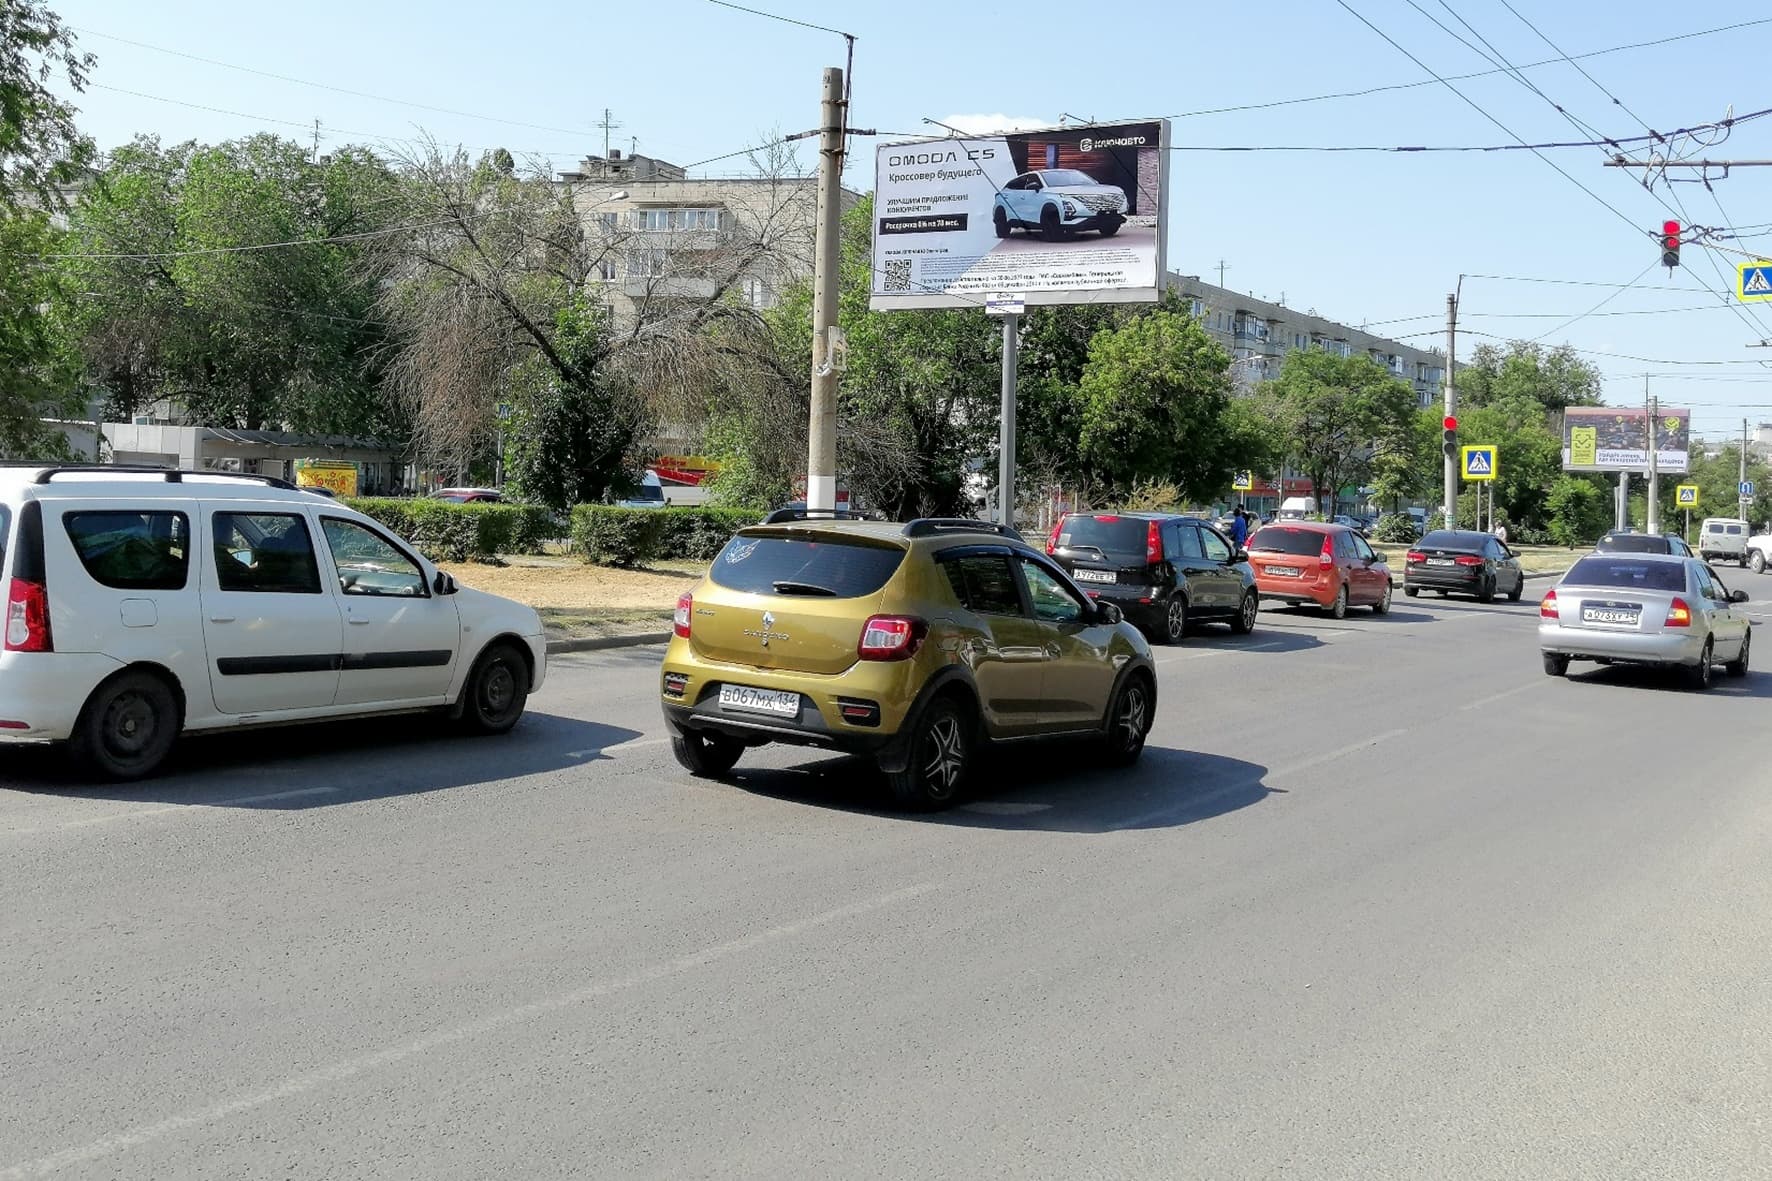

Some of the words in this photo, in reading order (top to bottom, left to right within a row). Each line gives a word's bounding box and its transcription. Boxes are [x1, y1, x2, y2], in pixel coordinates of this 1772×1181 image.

[889, 151, 957, 167] OMODA
[967, 148, 995, 161] C5
[889, 172, 935, 184] Кроссовер
[937, 168, 982, 180] будущего
[921, 193, 968, 204] ПРЕДЛОЖЕНИЕ
[887, 205, 931, 214] КОНКУРЕНТОВ
